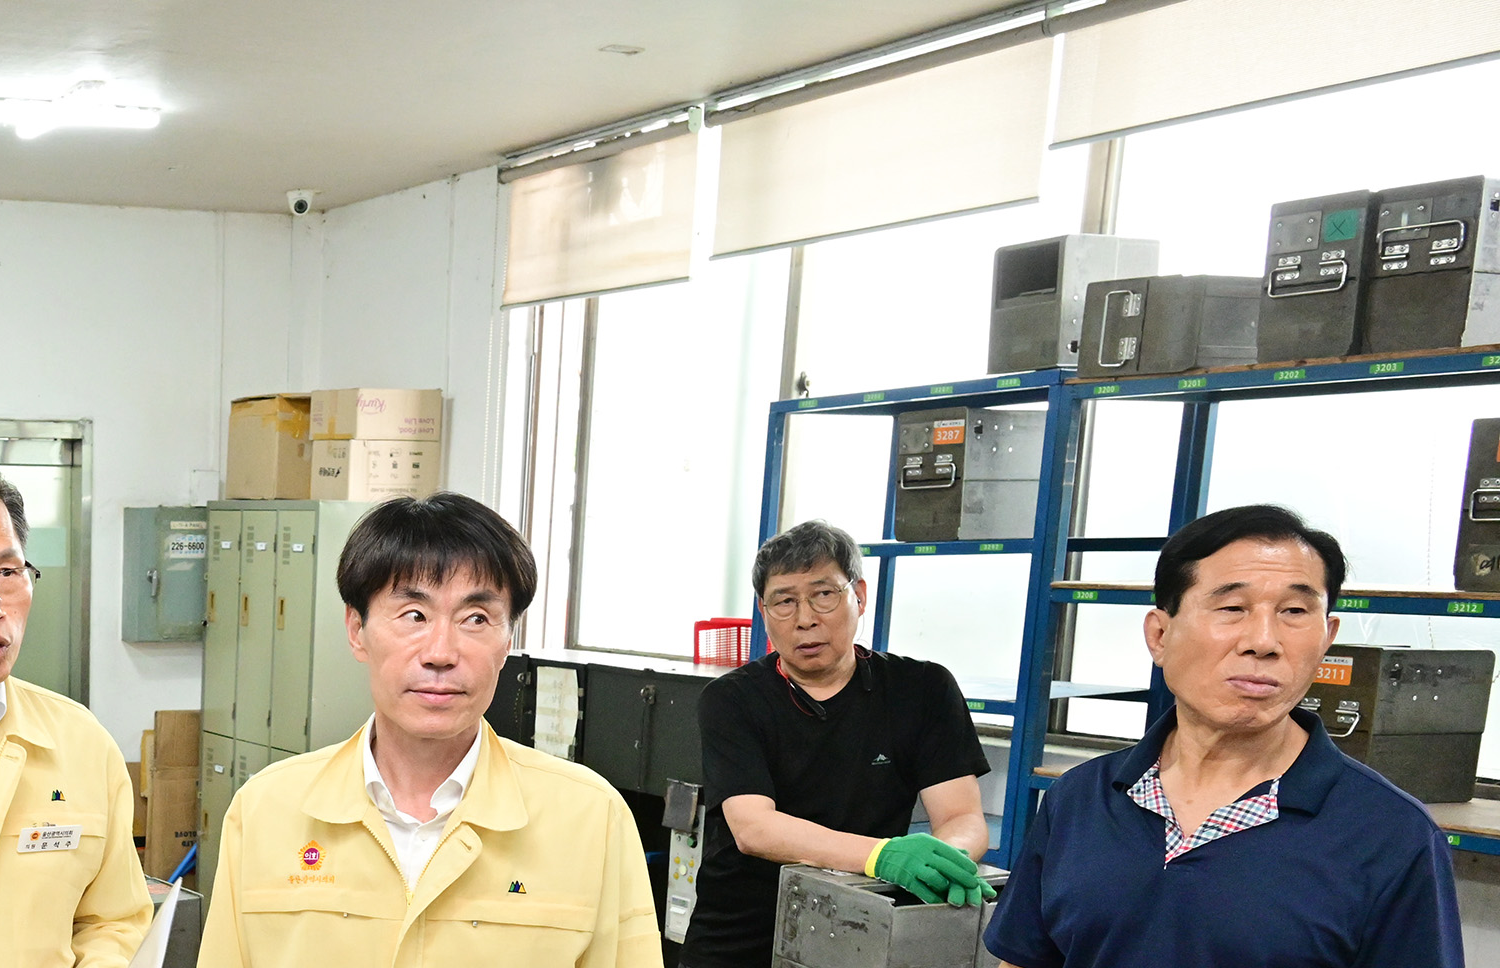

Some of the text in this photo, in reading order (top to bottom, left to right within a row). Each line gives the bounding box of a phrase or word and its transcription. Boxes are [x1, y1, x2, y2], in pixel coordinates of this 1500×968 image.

[1278, 371, 1300, 379] 3202
[1375, 363, 1397, 372] 3203
[356, 394, 386, 412] Kurly
[936, 430, 960, 441] 3287
[171, 542, 205, 551] 226-6600
[1342, 600, 1363, 609] 3211
[1453, 603, 1477, 613] 3212
[1316, 667, 1345, 680] 3211
